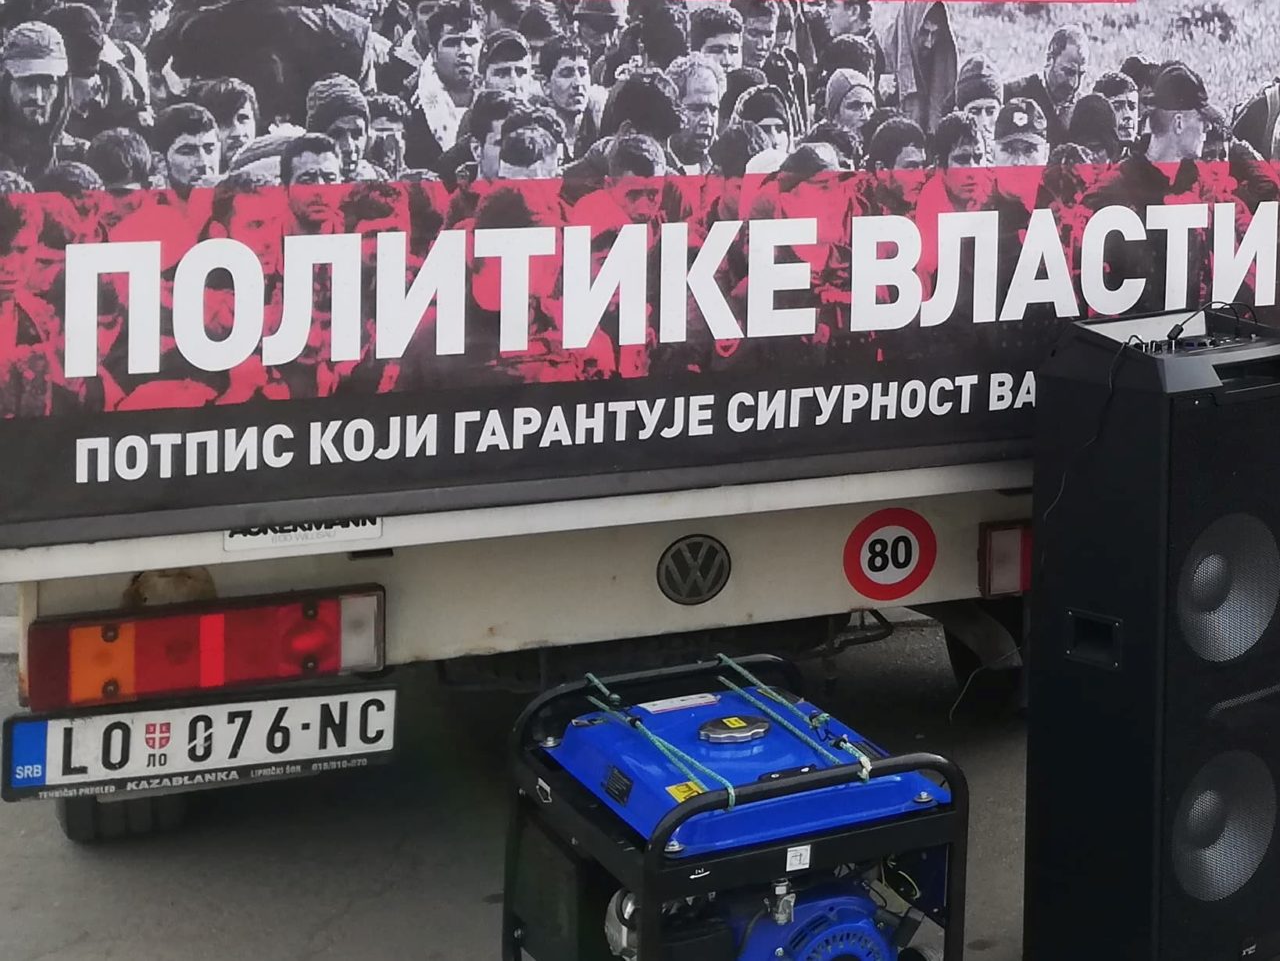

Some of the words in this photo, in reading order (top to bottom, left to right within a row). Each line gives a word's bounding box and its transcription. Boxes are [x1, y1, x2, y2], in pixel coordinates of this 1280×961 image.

[64, 217, 818, 379] ПОЛИТИКЕ
[851, 200, 1279, 332] ВЛАСТИ
[75, 421, 295, 484] ПОТПИС
[309, 412, 439, 466] КОЈИ
[453, 394, 714, 455] ГАРАНТУЈЕ
[726, 373, 979, 433] СИГУРНОСТ
[987, 370, 1037, 411] ВА
[867, 535, 913, 573] 80
[62, 720, 132, 776] LO
[15, 764, 43, 780] SRB
[126, 770, 240, 791] KAZABLANKA
